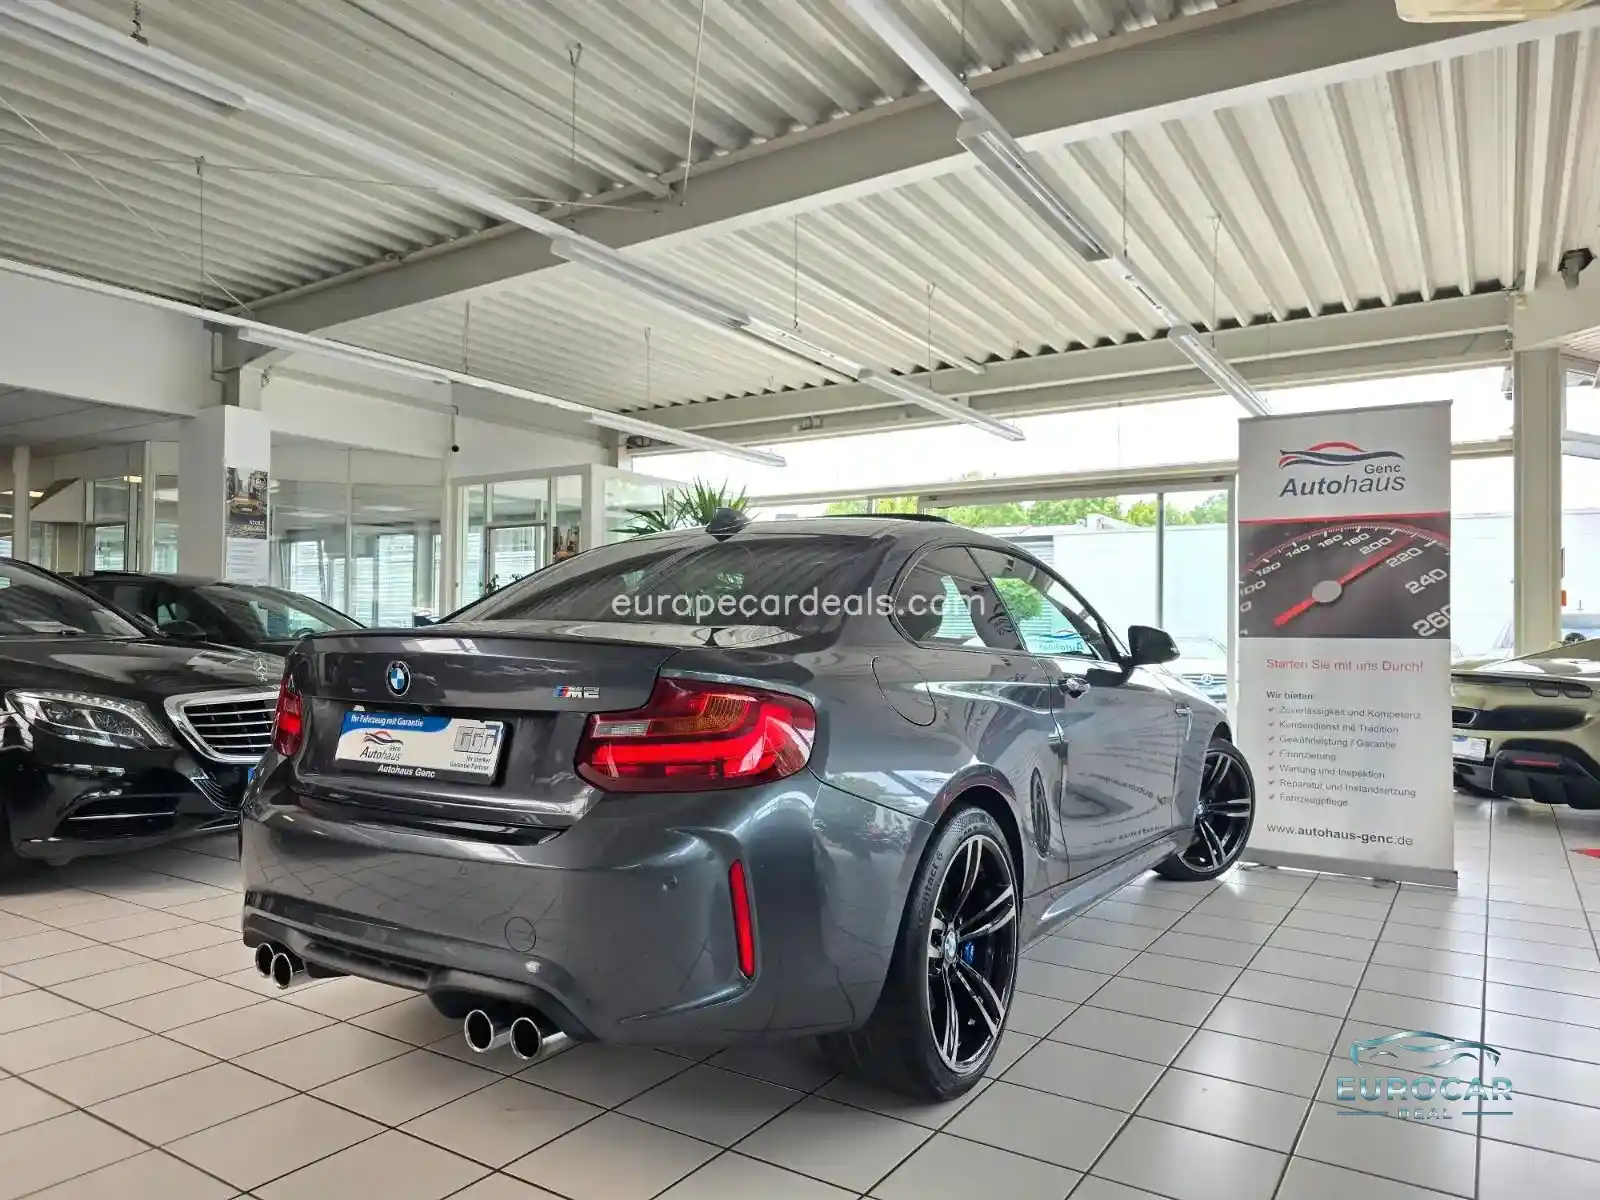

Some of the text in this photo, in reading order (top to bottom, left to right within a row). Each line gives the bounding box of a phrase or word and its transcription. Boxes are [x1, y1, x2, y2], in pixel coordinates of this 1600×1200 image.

[1364, 464, 1401, 474] Genc
[1279, 475, 1406, 497] Autohaus
[1286, 545, 1310, 559] 140
[1360, 537, 1392, 555] 200
[1386, 548, 1423, 568] 220
[1405, 568, 1447, 594] 240
[1266, 659, 1424, 672] Starten Sie mit uns Durch!
[566, 686, 600, 699] M2
[1266, 690, 1281, 699] Wir
[359, 714, 386, 727] Fahrzeug
[397, 717, 424, 728] Garantie
[1359, 724, 1399, 734] Tradition
[1356, 739, 1397, 749] Garantie
[360, 746, 401, 761] Autohaus
[378, 764, 436, 778] Autohaus Genc
[1279, 764, 1317, 776] Wartung
[1338, 768, 1386, 779] Inspektion
[1279, 779, 1324, 791] Reparatur
[1266, 823, 1414, 846] www.autohaus-genc.de
